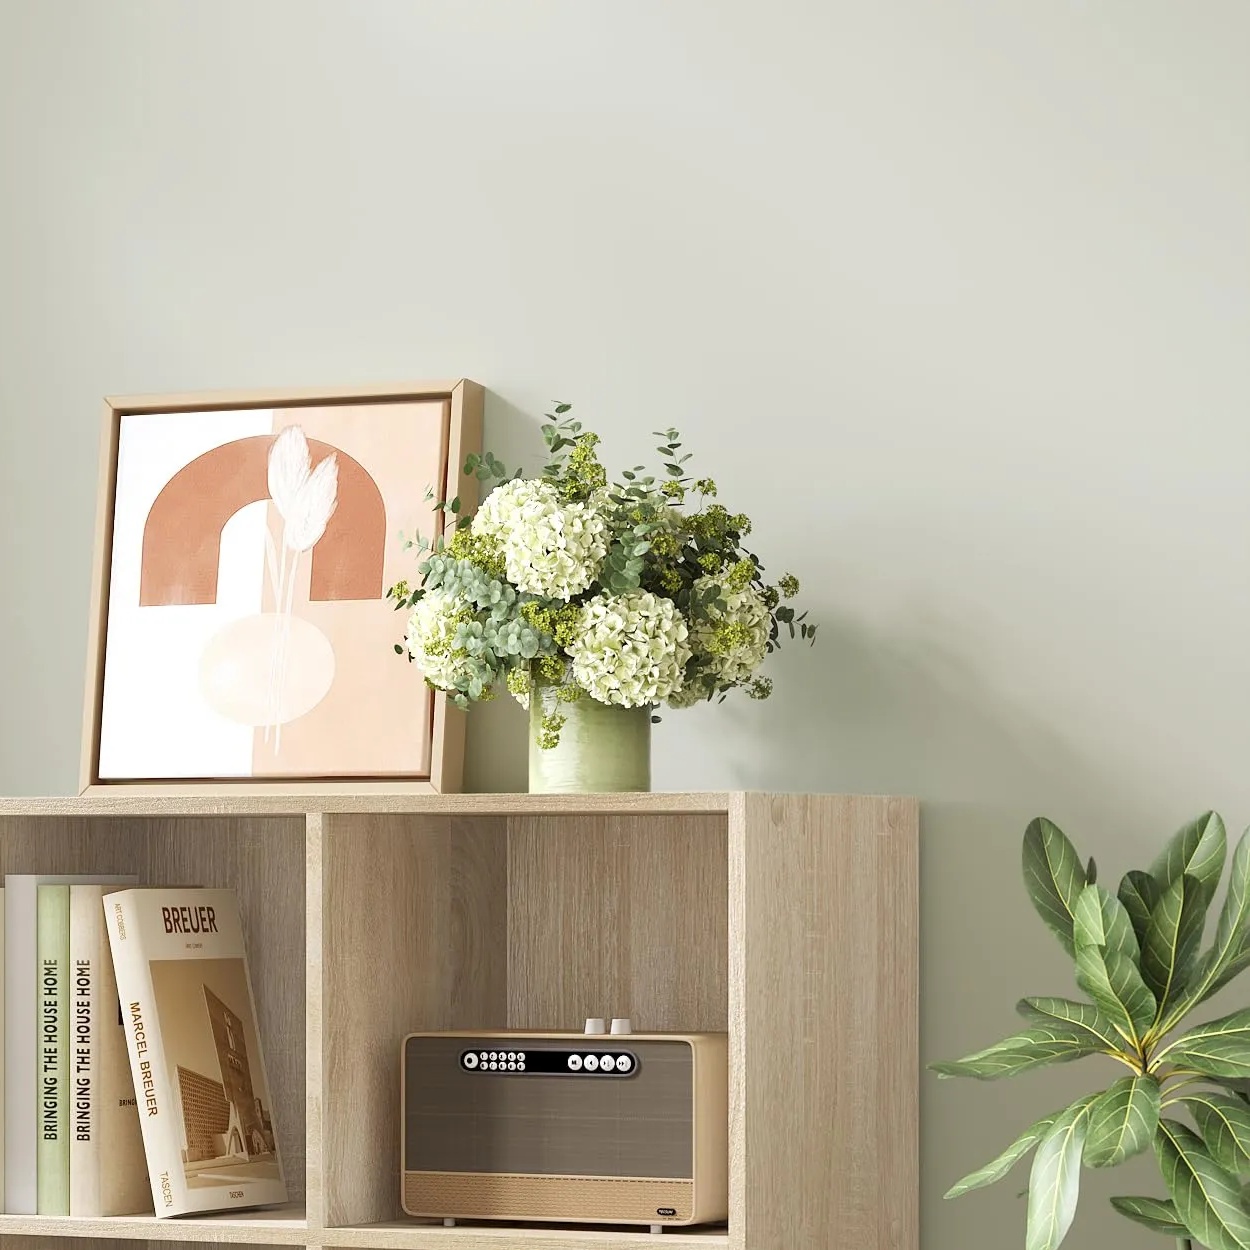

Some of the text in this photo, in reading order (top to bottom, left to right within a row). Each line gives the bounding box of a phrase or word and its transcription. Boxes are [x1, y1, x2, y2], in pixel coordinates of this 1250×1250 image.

[161, 906, 219, 934] BREUER
[43, 959, 58, 1140] BRINGING THE HOUSE HOME
[76, 959, 91, 1141] BRINGING THE HOUSE HOME
[129, 1001, 158, 1117] MARCEL BREUER
[158, 1171, 174, 1208] TASCEN
